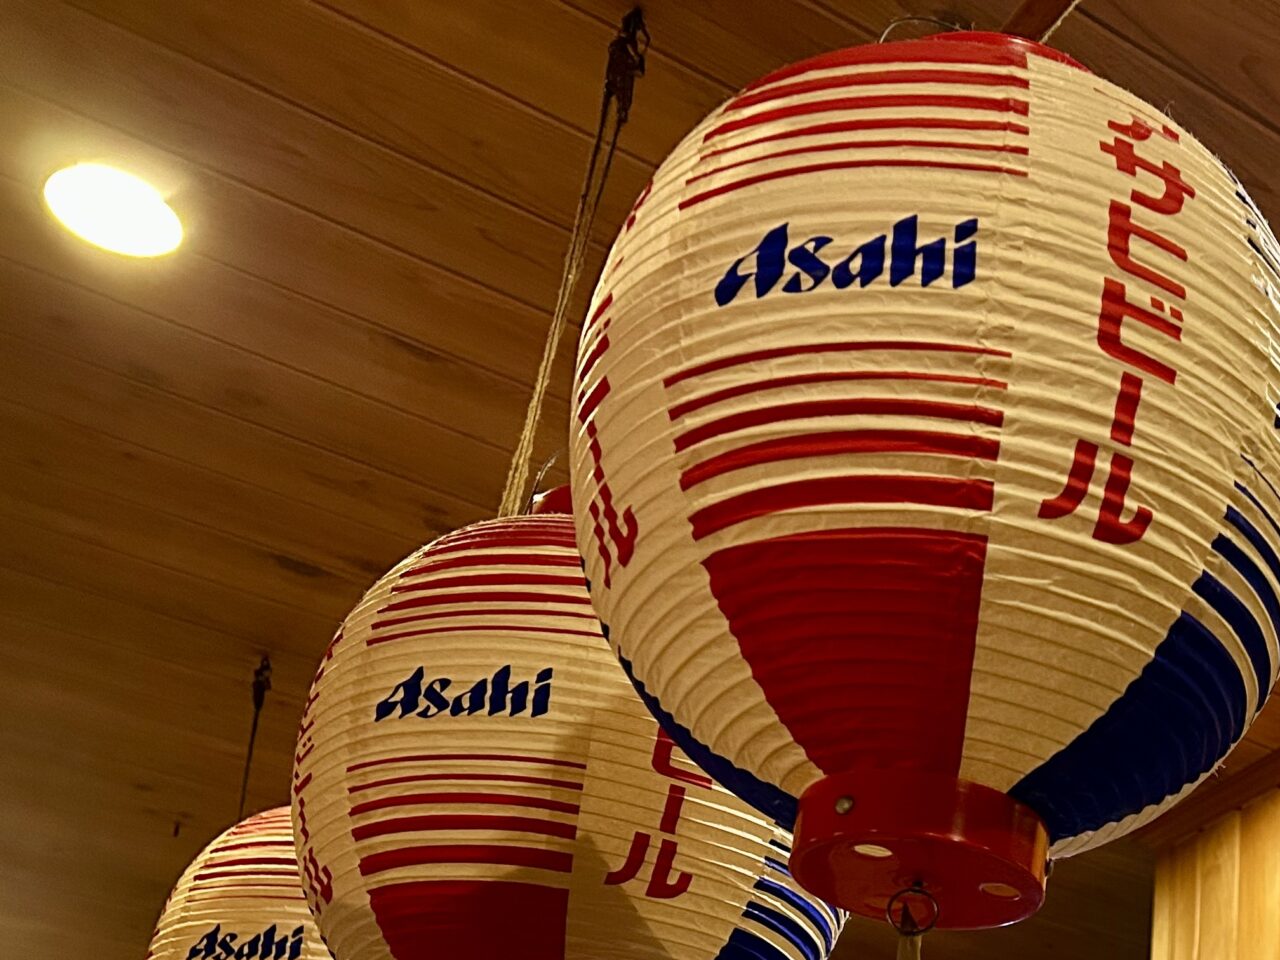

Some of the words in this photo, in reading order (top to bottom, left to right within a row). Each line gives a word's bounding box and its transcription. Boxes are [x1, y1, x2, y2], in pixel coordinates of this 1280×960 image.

[714, 214, 979, 306] Asahi
[1037, 112, 1196, 546] アサヒビール
[374, 664, 554, 722] Asahi
